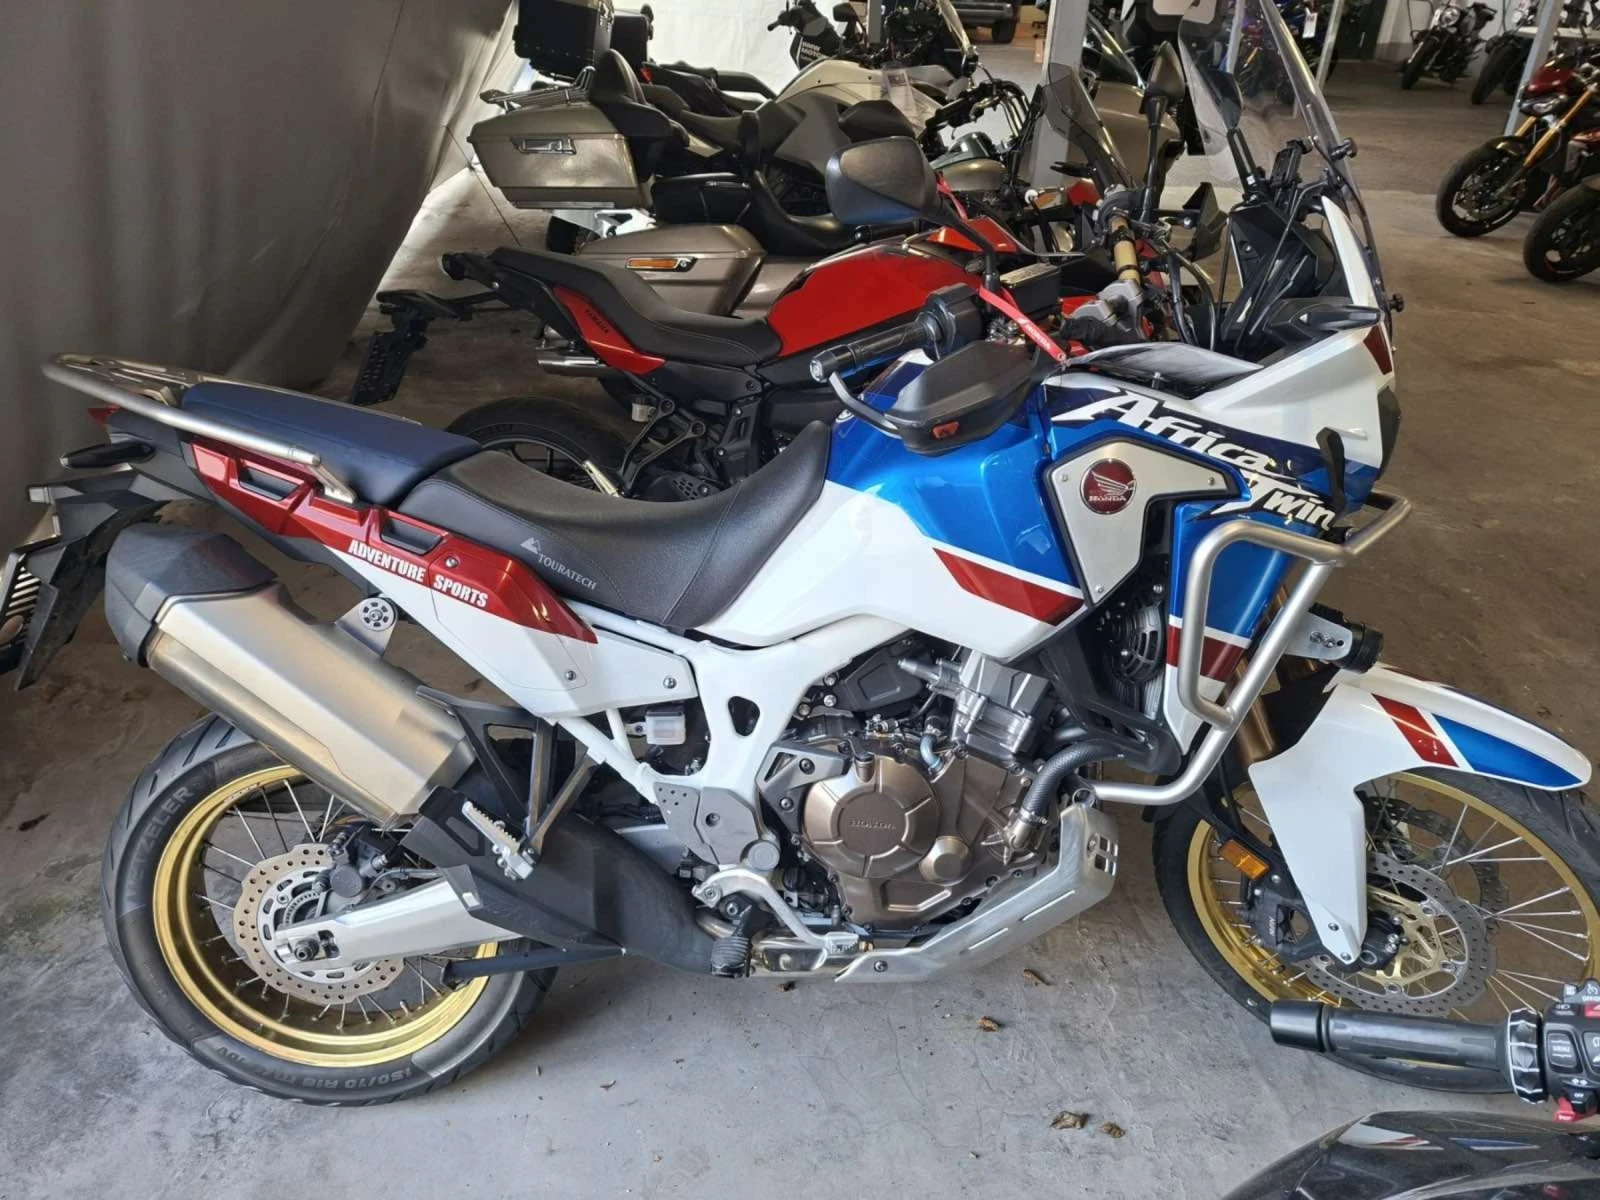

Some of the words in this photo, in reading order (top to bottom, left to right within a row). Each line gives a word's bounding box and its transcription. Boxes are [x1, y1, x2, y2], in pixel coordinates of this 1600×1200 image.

[1051, 388, 1296, 480] Africa
[1210, 468, 1336, 531] Twin
[348, 539, 427, 583] ADVENTURE
[433, 574, 489, 608] SPORTS
[537, 552, 597, 590] TOURATECH
